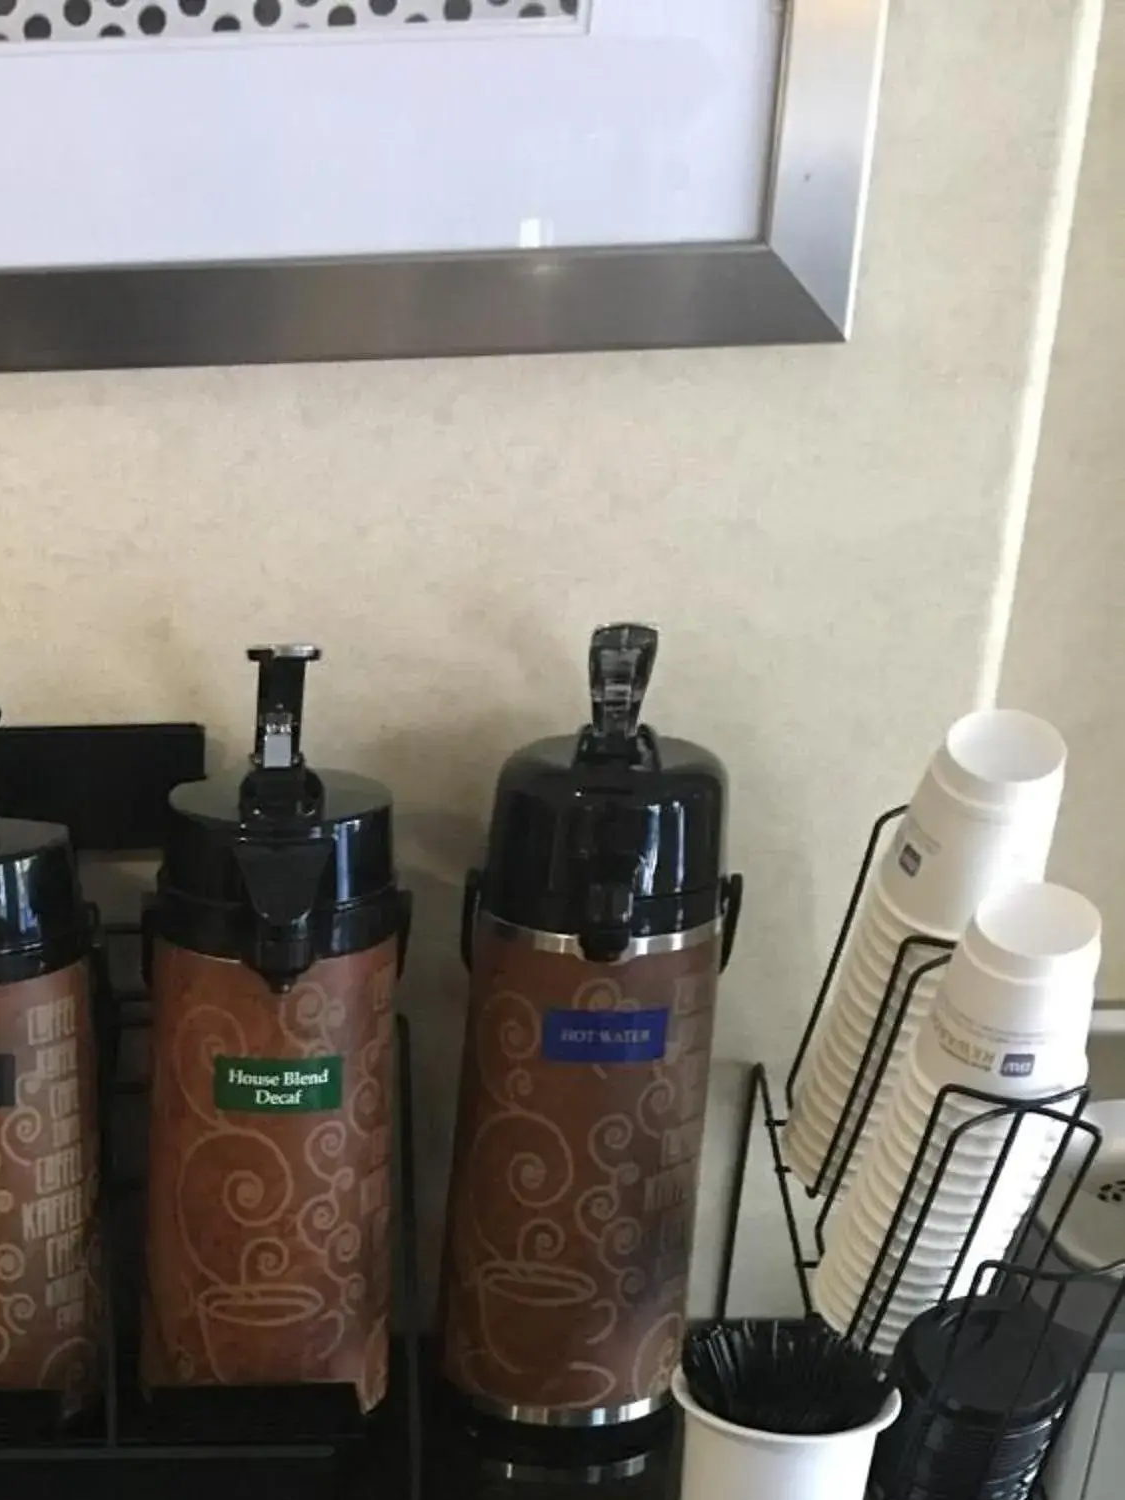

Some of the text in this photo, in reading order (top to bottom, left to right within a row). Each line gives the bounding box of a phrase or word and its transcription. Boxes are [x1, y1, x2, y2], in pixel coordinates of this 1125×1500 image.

[560, 1028, 651, 1043] HOT WATER
[228, 1068, 329, 1086] House Blend
[255, 1089, 303, 1105] Decaf
